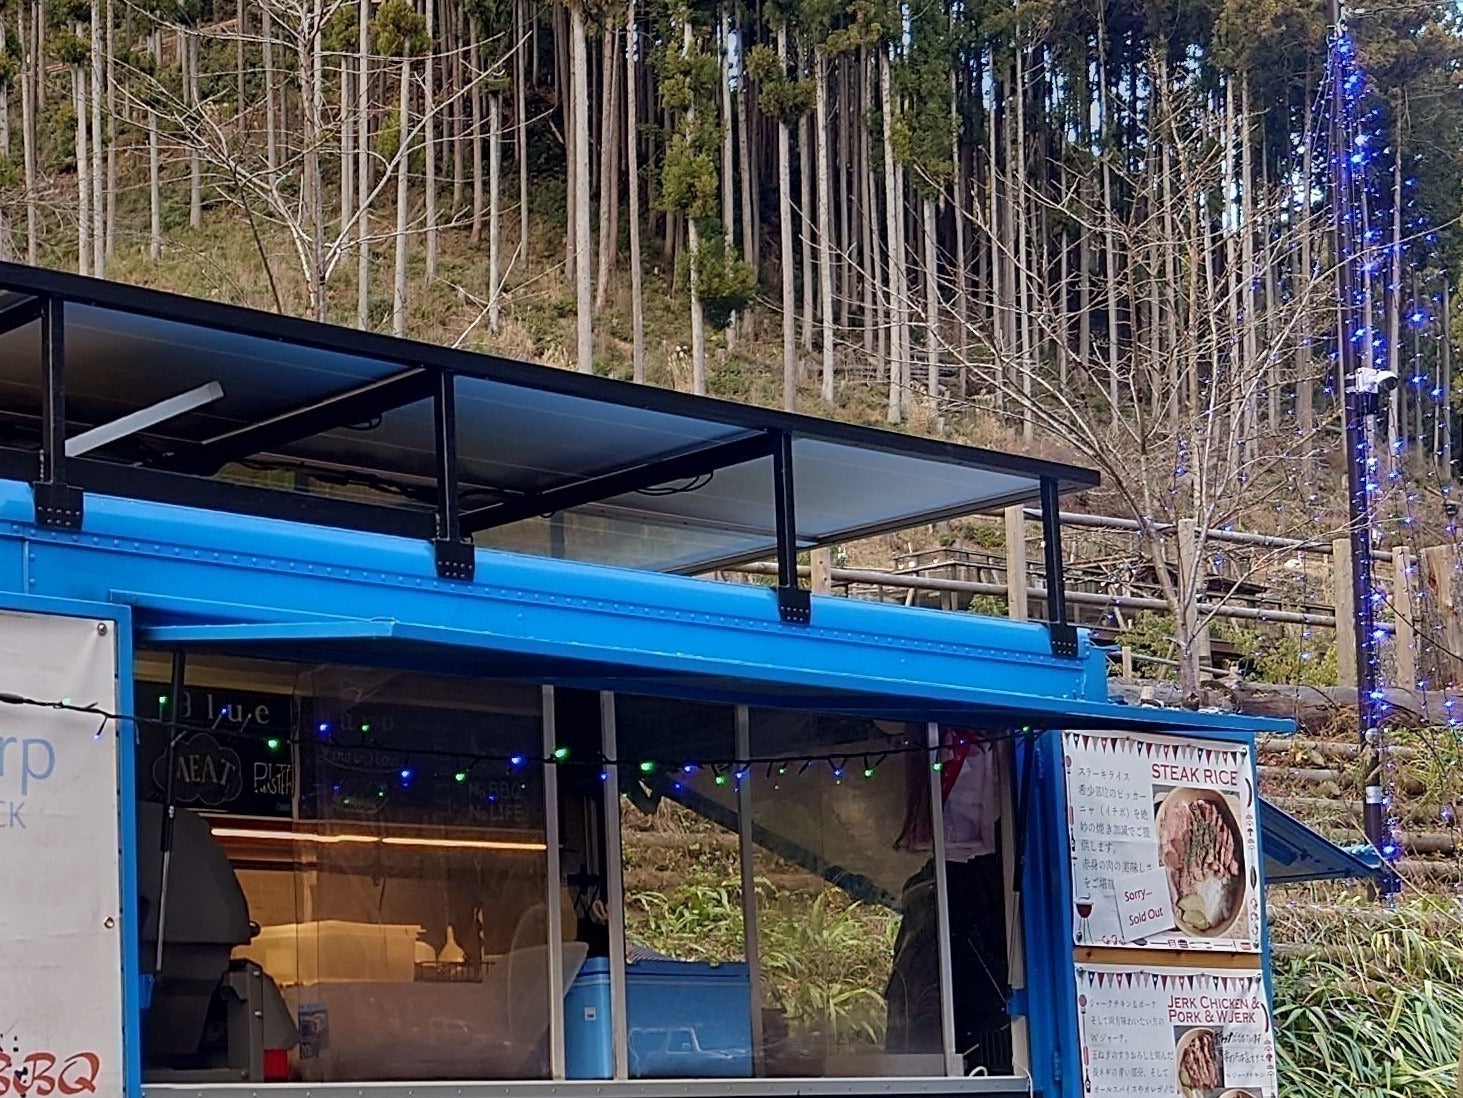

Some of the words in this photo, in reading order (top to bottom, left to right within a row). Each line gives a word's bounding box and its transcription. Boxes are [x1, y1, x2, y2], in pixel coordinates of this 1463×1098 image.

[1152, 764, 1201, 784] STEAK
[1204, 769, 1238, 786] RICE
[1129, 911, 1147, 926] Sold
[1147, 907, 1164, 920] Out
[1167, 995, 1196, 1009] JERK
[1200, 995, 1249, 1009] CHICKEN
[1251, 996, 1260, 1010] &
[1168, 1009, 1201, 1023] PORK
[1205, 1009, 1216, 1023] &
